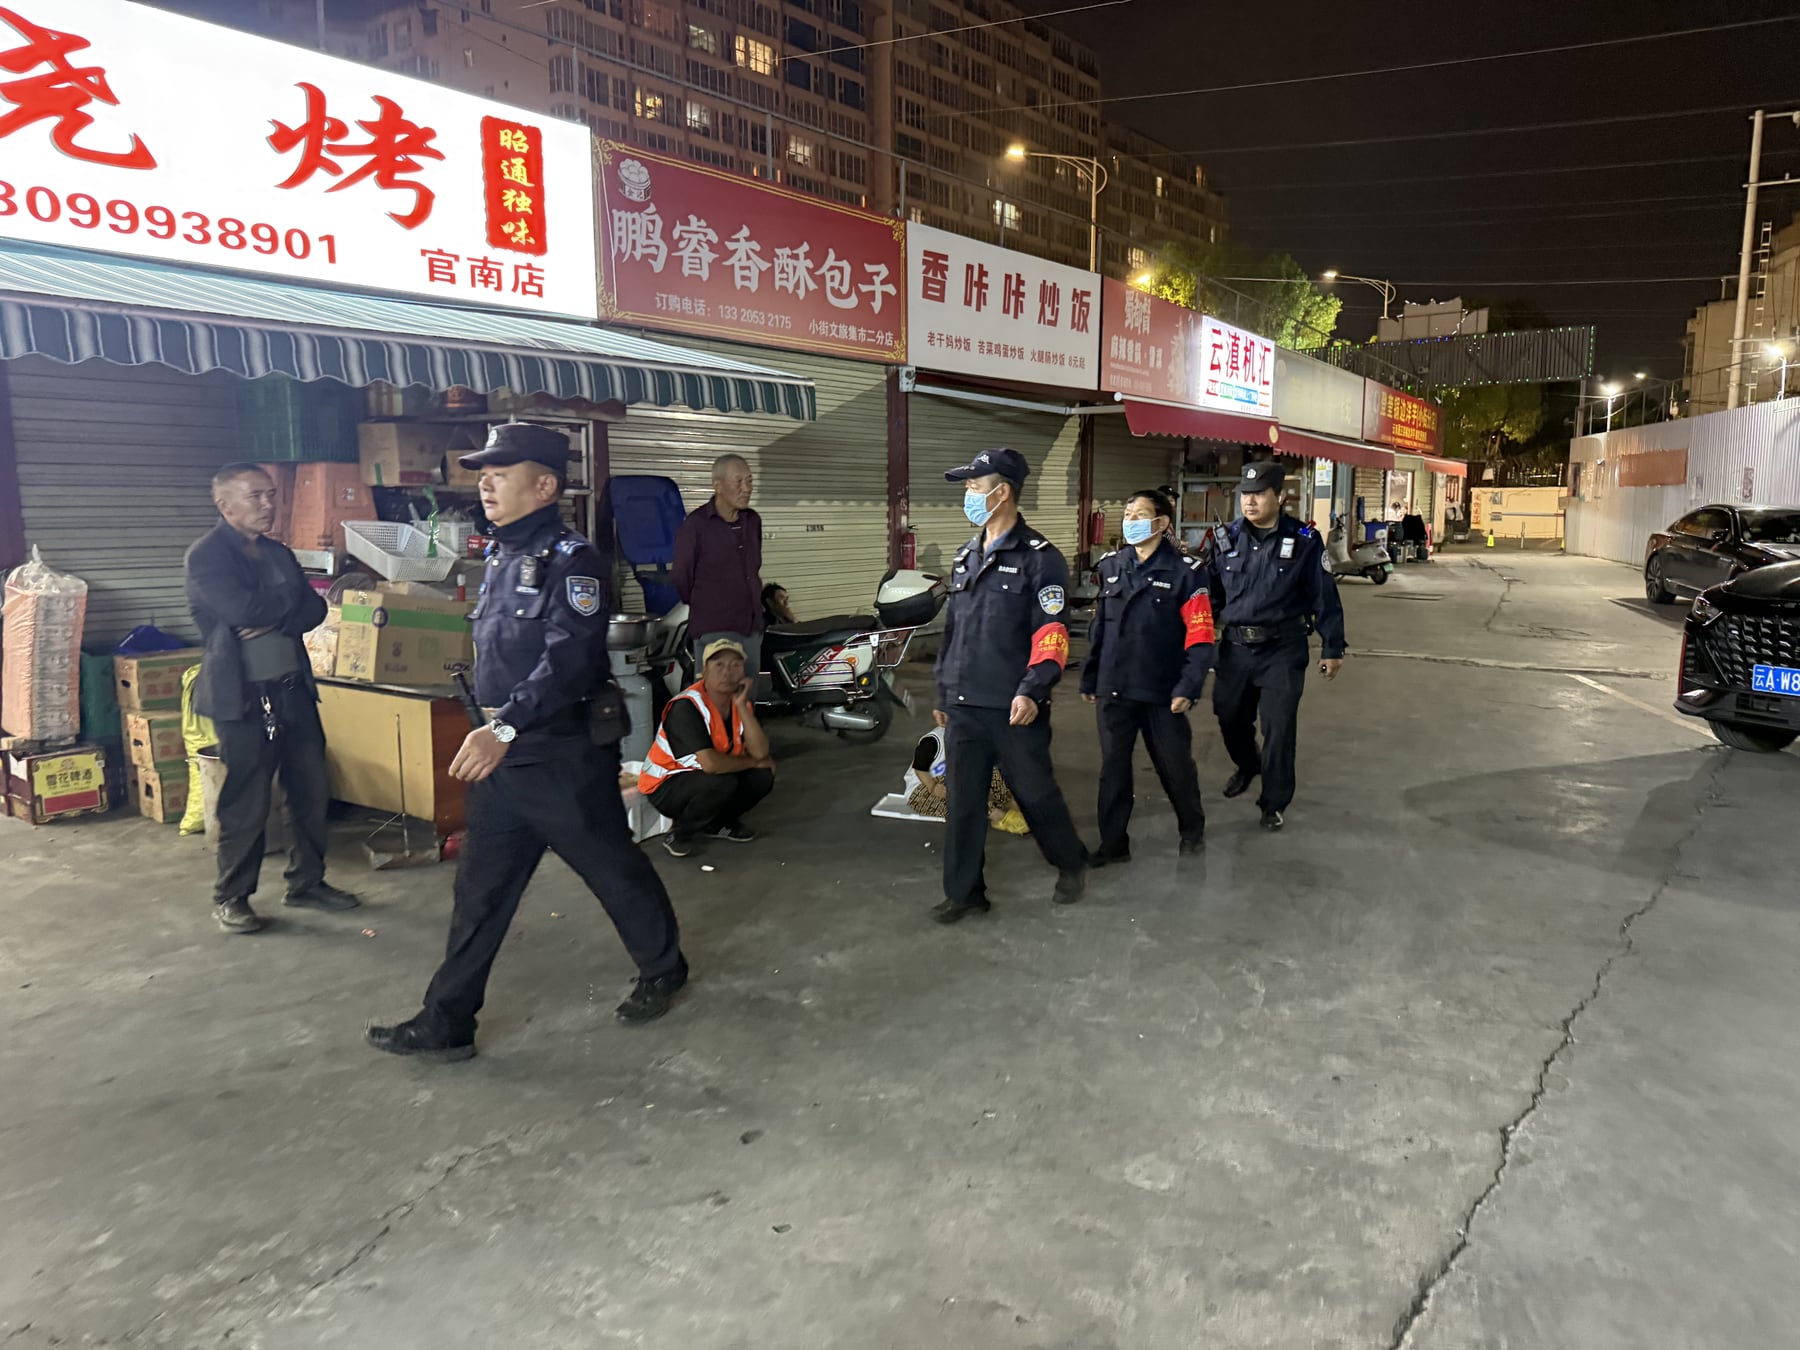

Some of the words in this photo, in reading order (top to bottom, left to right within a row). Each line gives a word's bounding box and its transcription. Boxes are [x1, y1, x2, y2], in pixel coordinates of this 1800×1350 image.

[499, 128, 536, 246] 昭通独味
[420, 248, 546, 298] 官南店
[612, 202, 897, 314] 鹏睿香酥包子
[719, 304, 738, 321] 133
[922, 249, 1092, 334] 香咔咔炒饭
[927, 331, 972, 353] 老干妈炒饭
[1209, 328, 1272, 387] 云滇机汇
